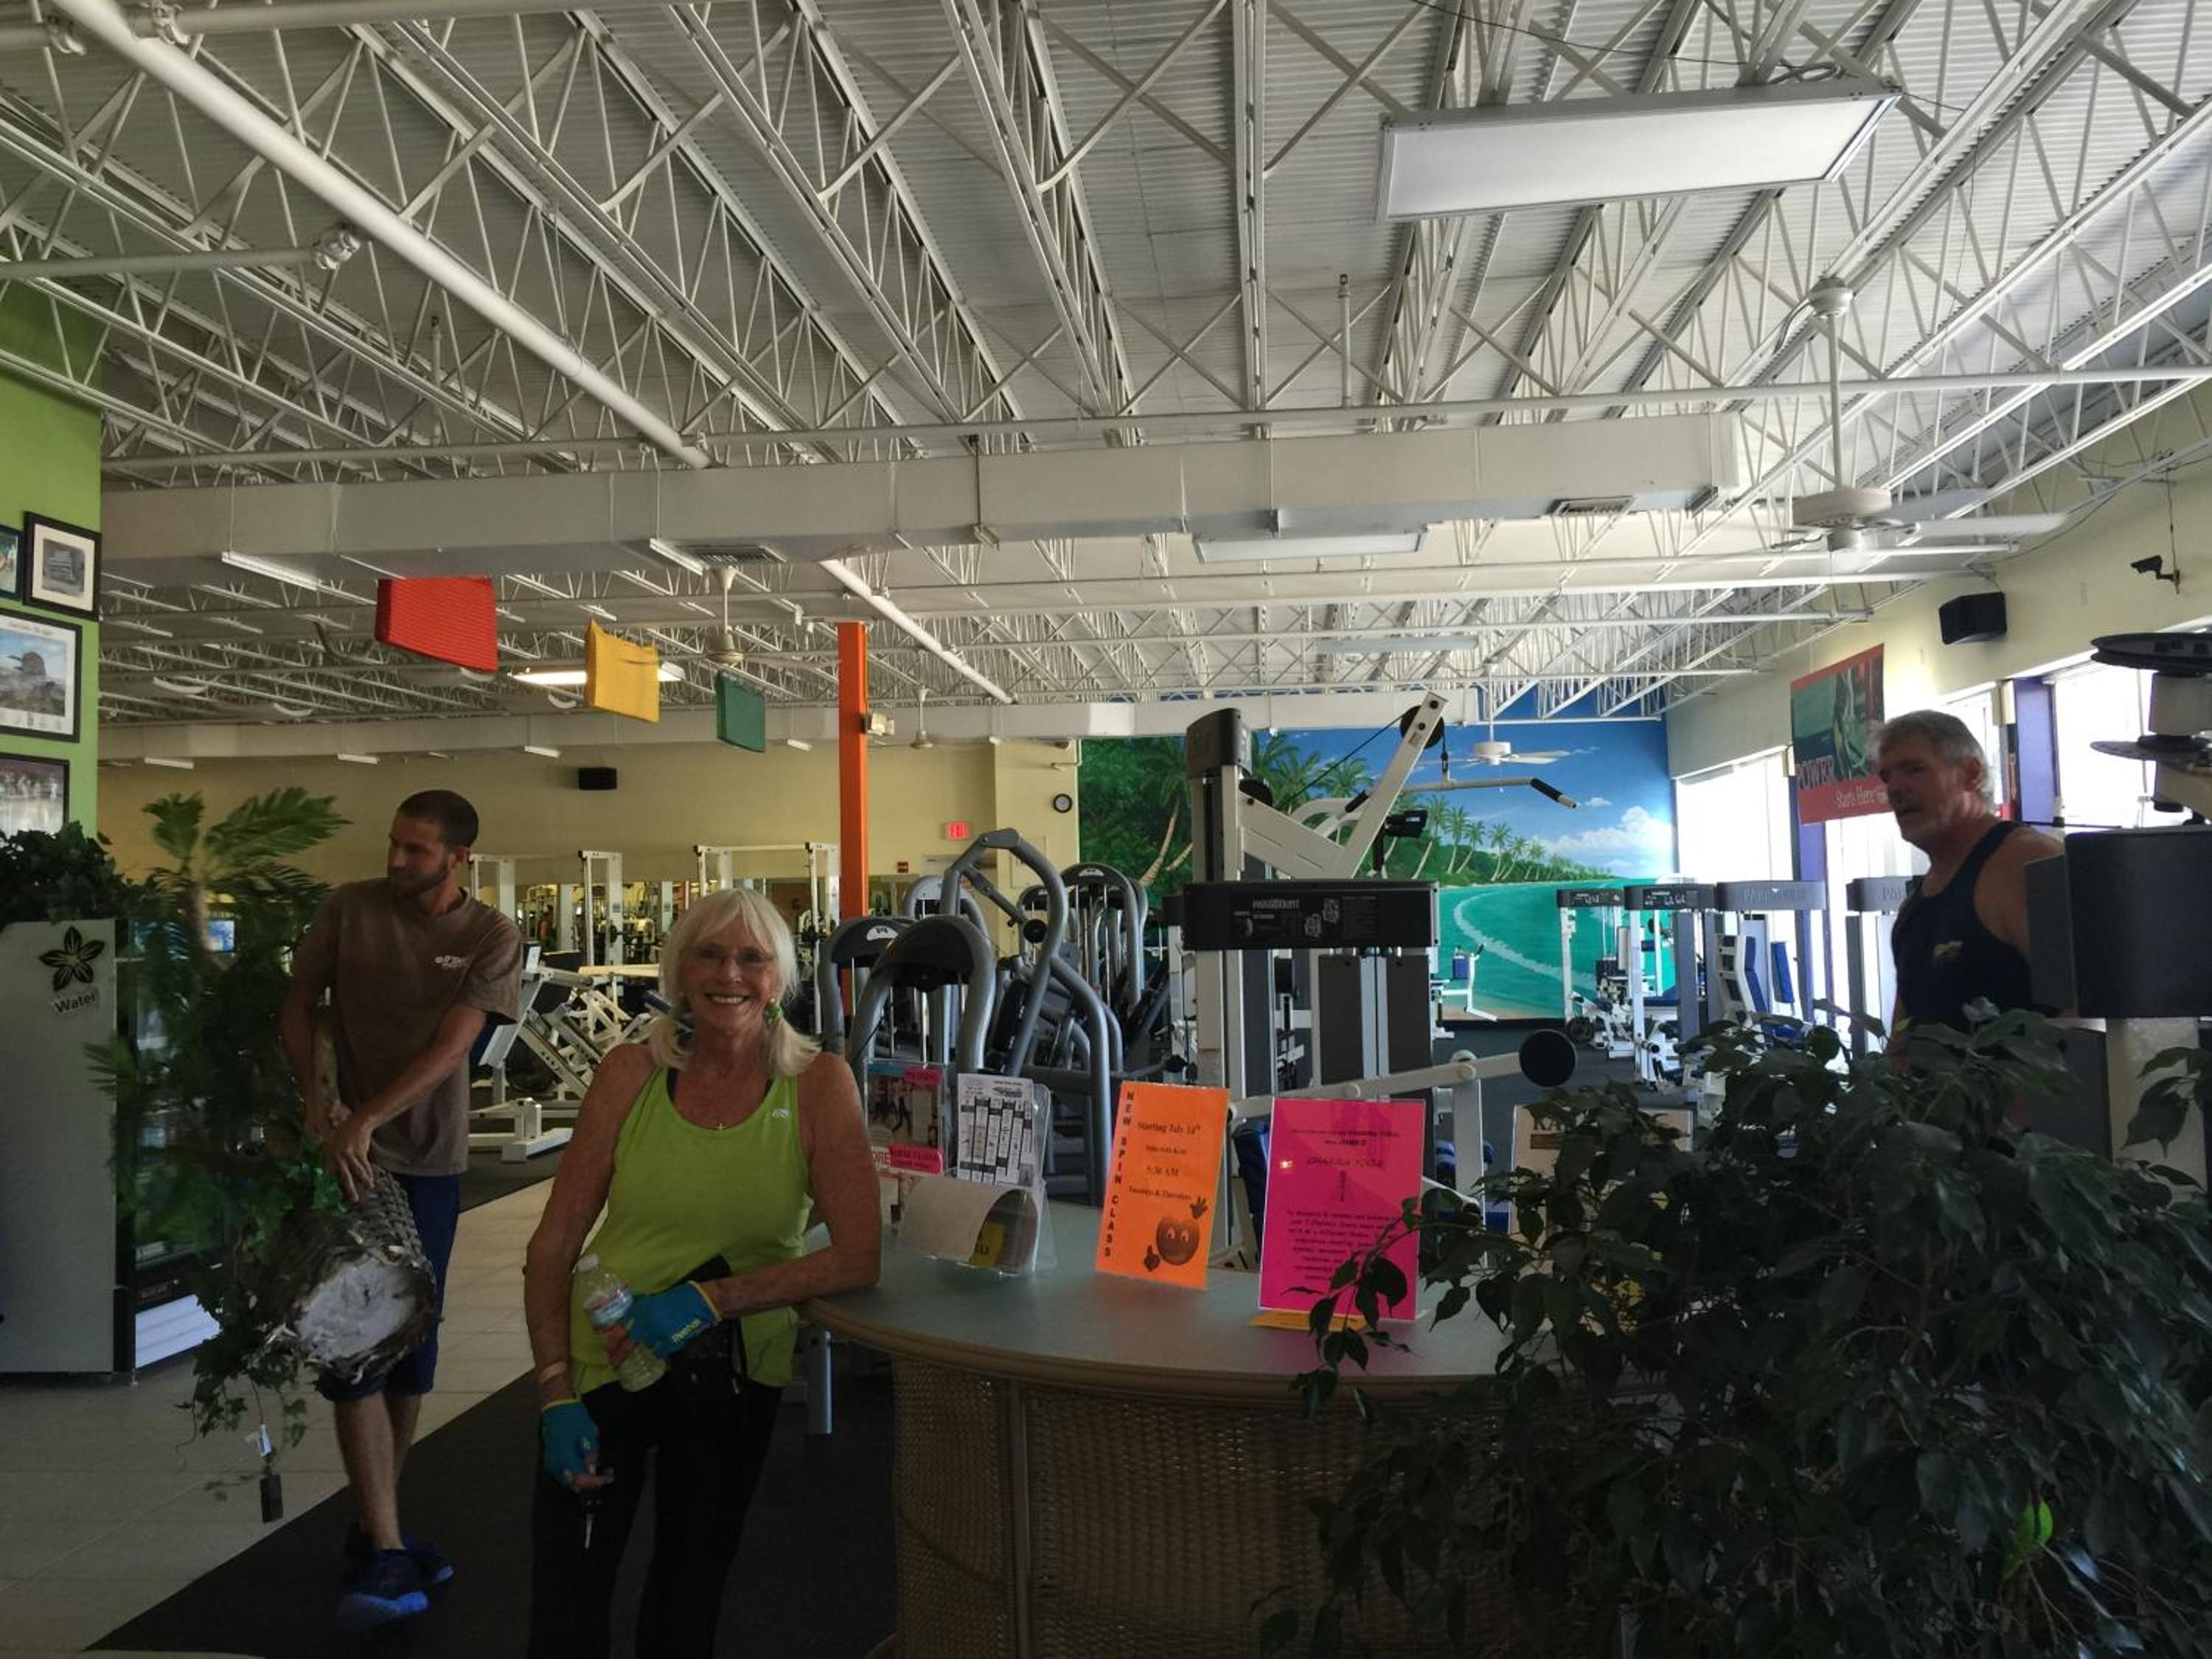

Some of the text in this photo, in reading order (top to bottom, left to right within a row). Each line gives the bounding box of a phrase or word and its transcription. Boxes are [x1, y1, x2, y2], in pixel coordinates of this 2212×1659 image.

[1795, 755, 1836, 790] POWER
[55, 992, 95, 1012] Water
[1138, 1121, 1167, 1133] Starting
[1169, 1123, 1183, 1134] July
[1104, 1091, 1135, 1257] NEW SPIN CLASS
